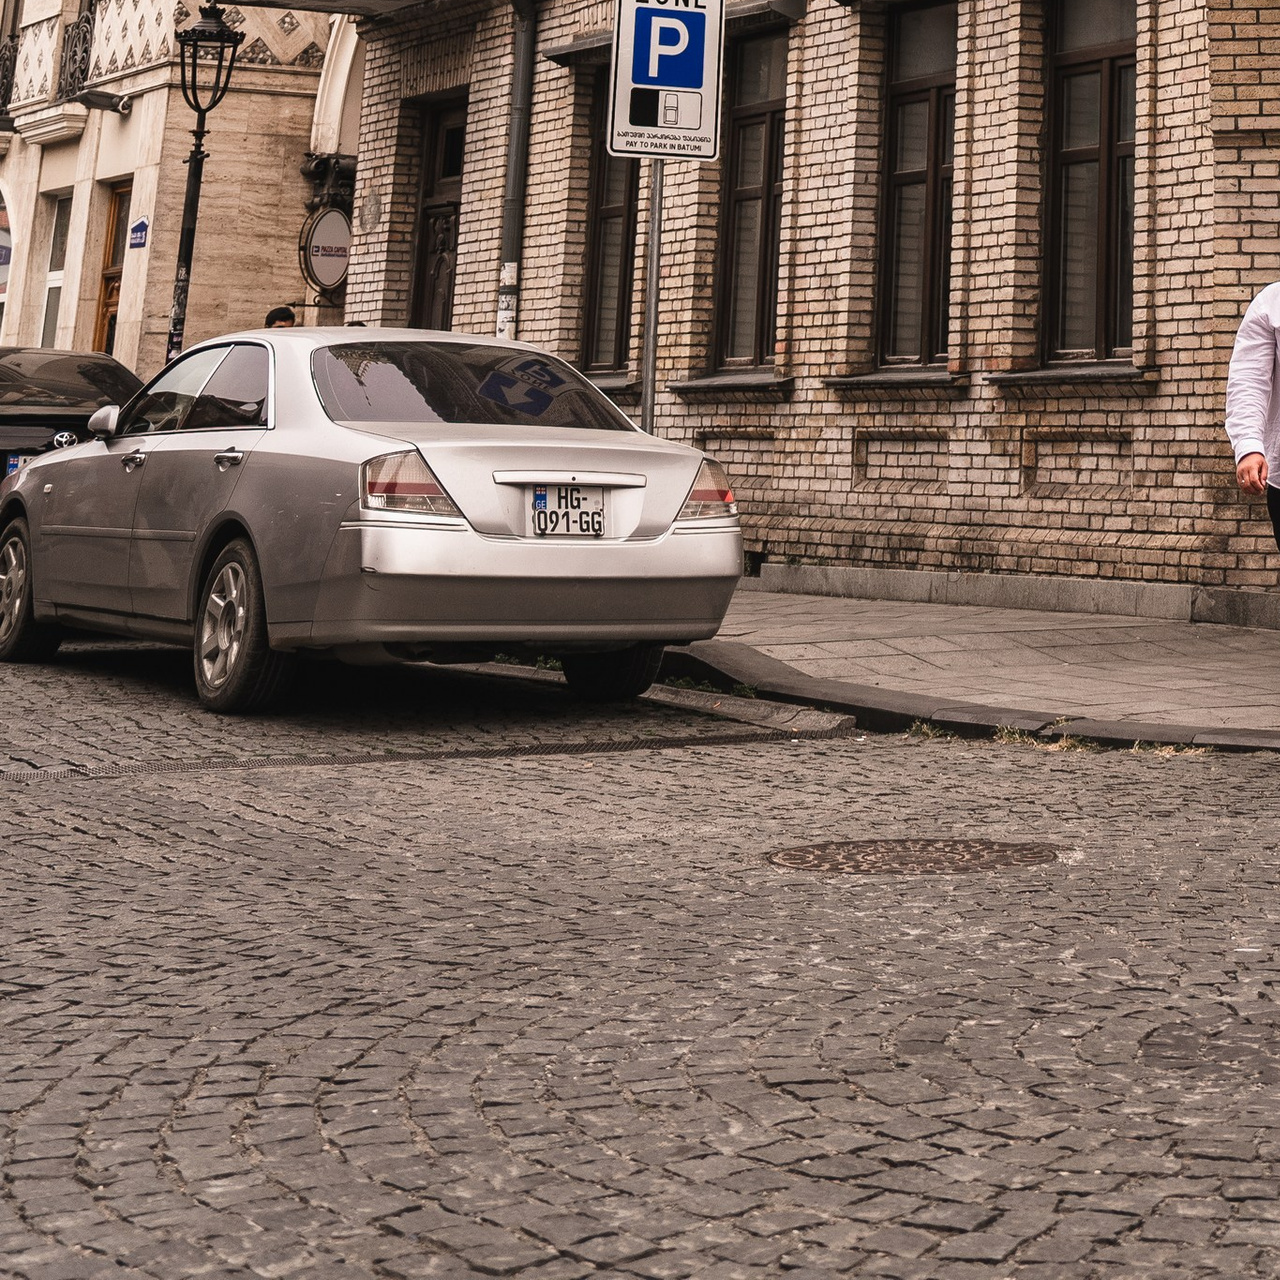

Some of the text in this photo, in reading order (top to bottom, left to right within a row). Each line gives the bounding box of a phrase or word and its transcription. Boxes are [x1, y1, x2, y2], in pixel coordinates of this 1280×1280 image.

[648, 16, 690, 78] P
[625, 140, 638, 148] PAY
[535, 500, 547, 510] GE
[536, 510, 602, 533] 091-GG
